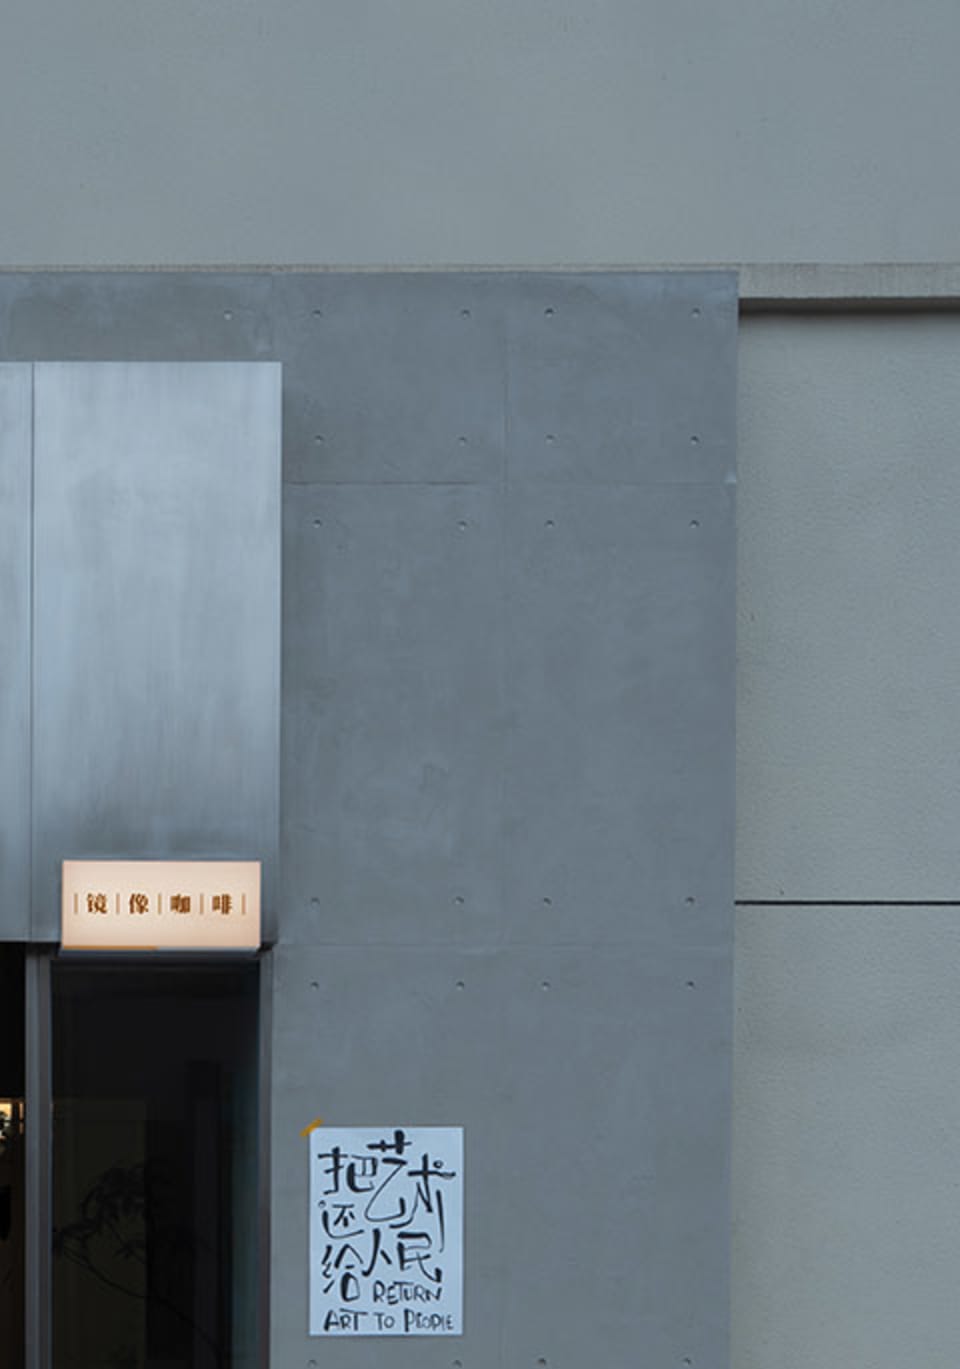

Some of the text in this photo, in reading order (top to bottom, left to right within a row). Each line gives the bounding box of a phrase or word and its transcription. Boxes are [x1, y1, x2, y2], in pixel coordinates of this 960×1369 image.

[87, 893, 232, 915] 镜像咖啡
[323, 1308, 368, 1331] ART
[373, 1312, 395, 1330] TO
